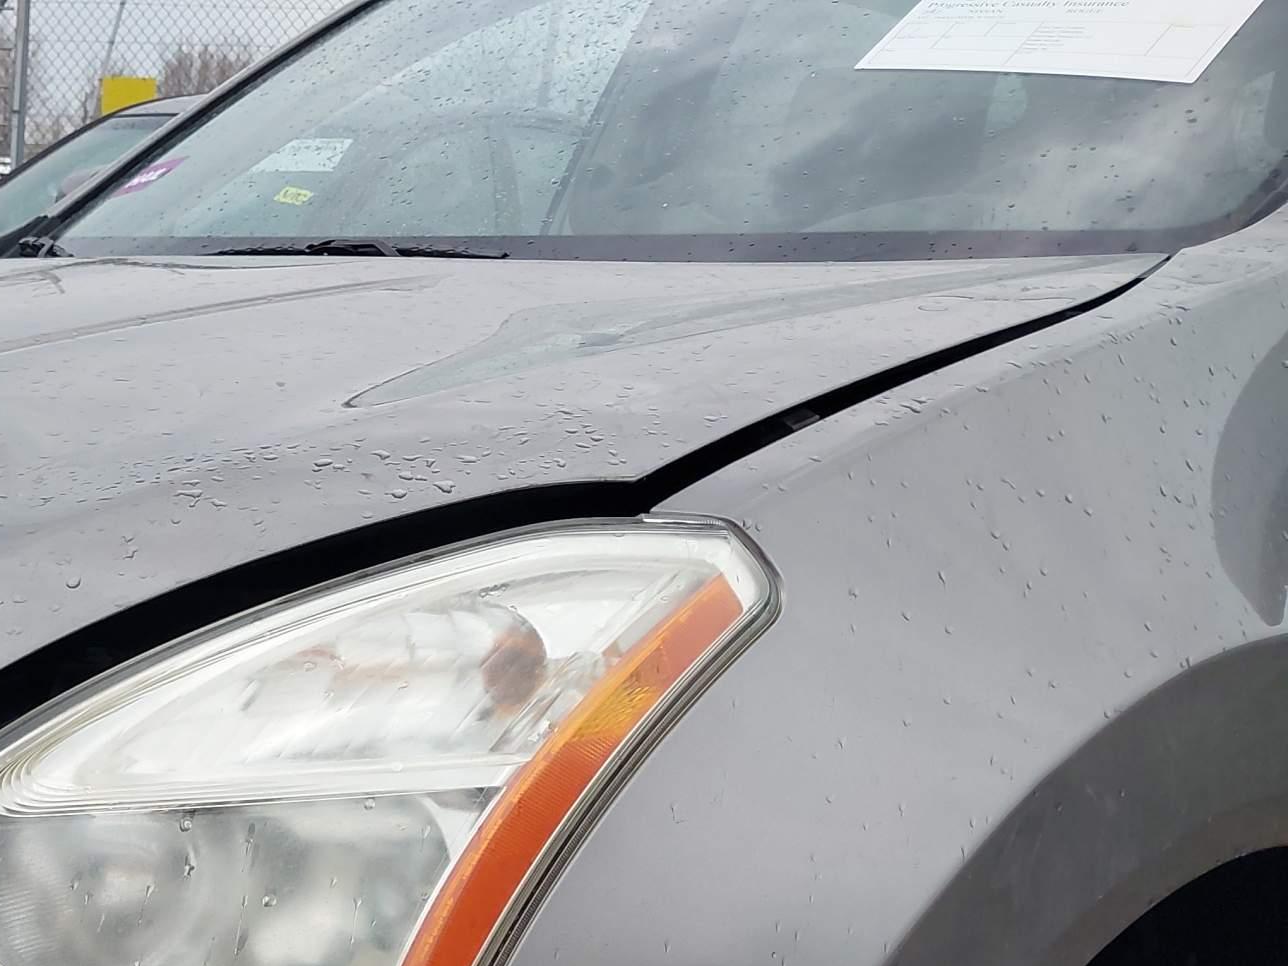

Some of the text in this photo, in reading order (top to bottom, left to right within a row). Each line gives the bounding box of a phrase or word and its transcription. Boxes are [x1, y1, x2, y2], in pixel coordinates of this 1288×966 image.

[926, 0, 1130, 9] Progressive Casualty Insurance
